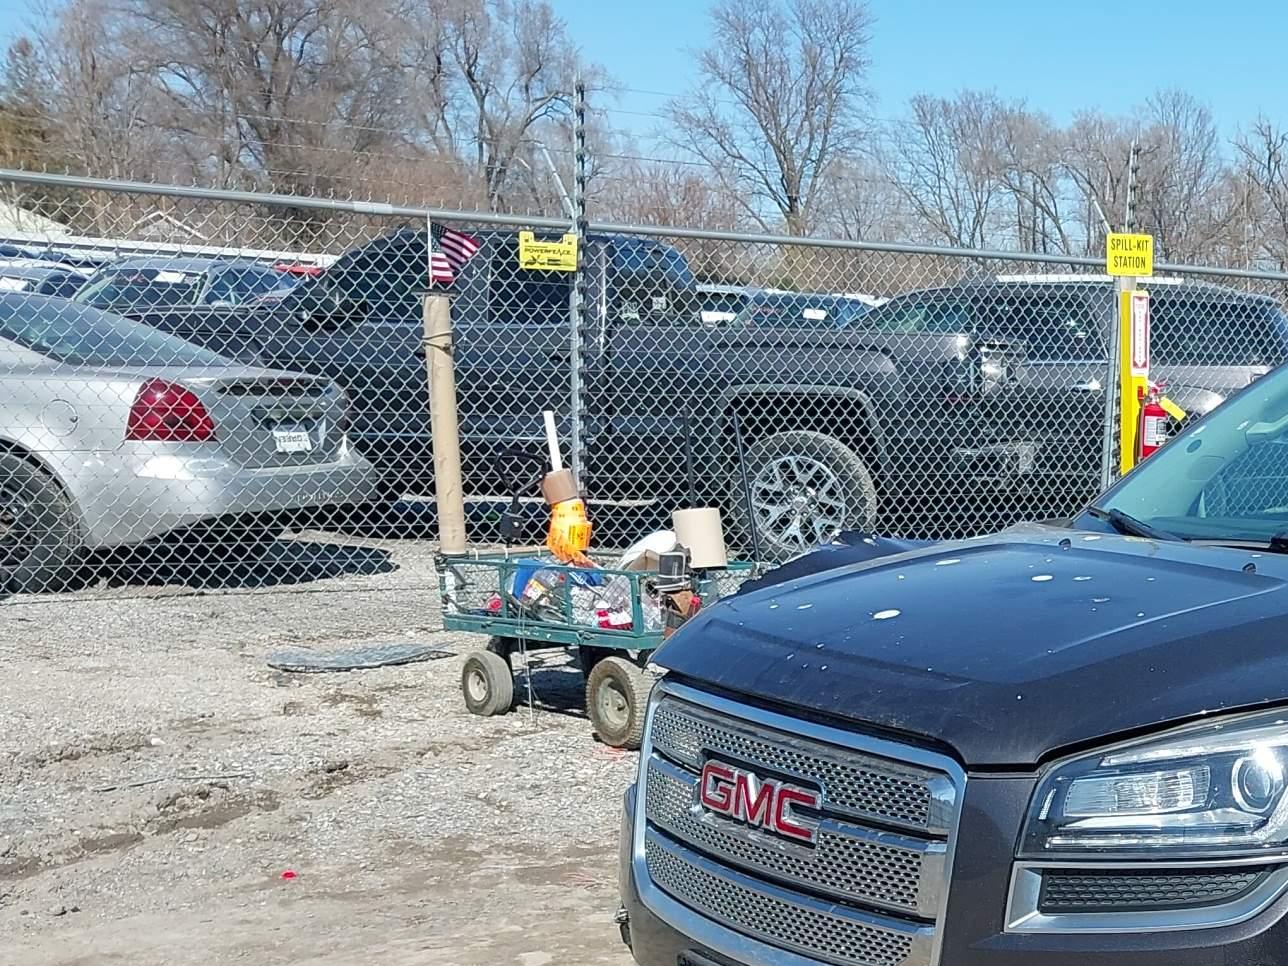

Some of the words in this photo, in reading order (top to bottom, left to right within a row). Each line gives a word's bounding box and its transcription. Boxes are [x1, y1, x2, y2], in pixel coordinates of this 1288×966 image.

[1111, 238, 1149, 252] SPILL-KIT
[1114, 255, 1146, 269] STATION
[701, 759, 821, 843] GMC
